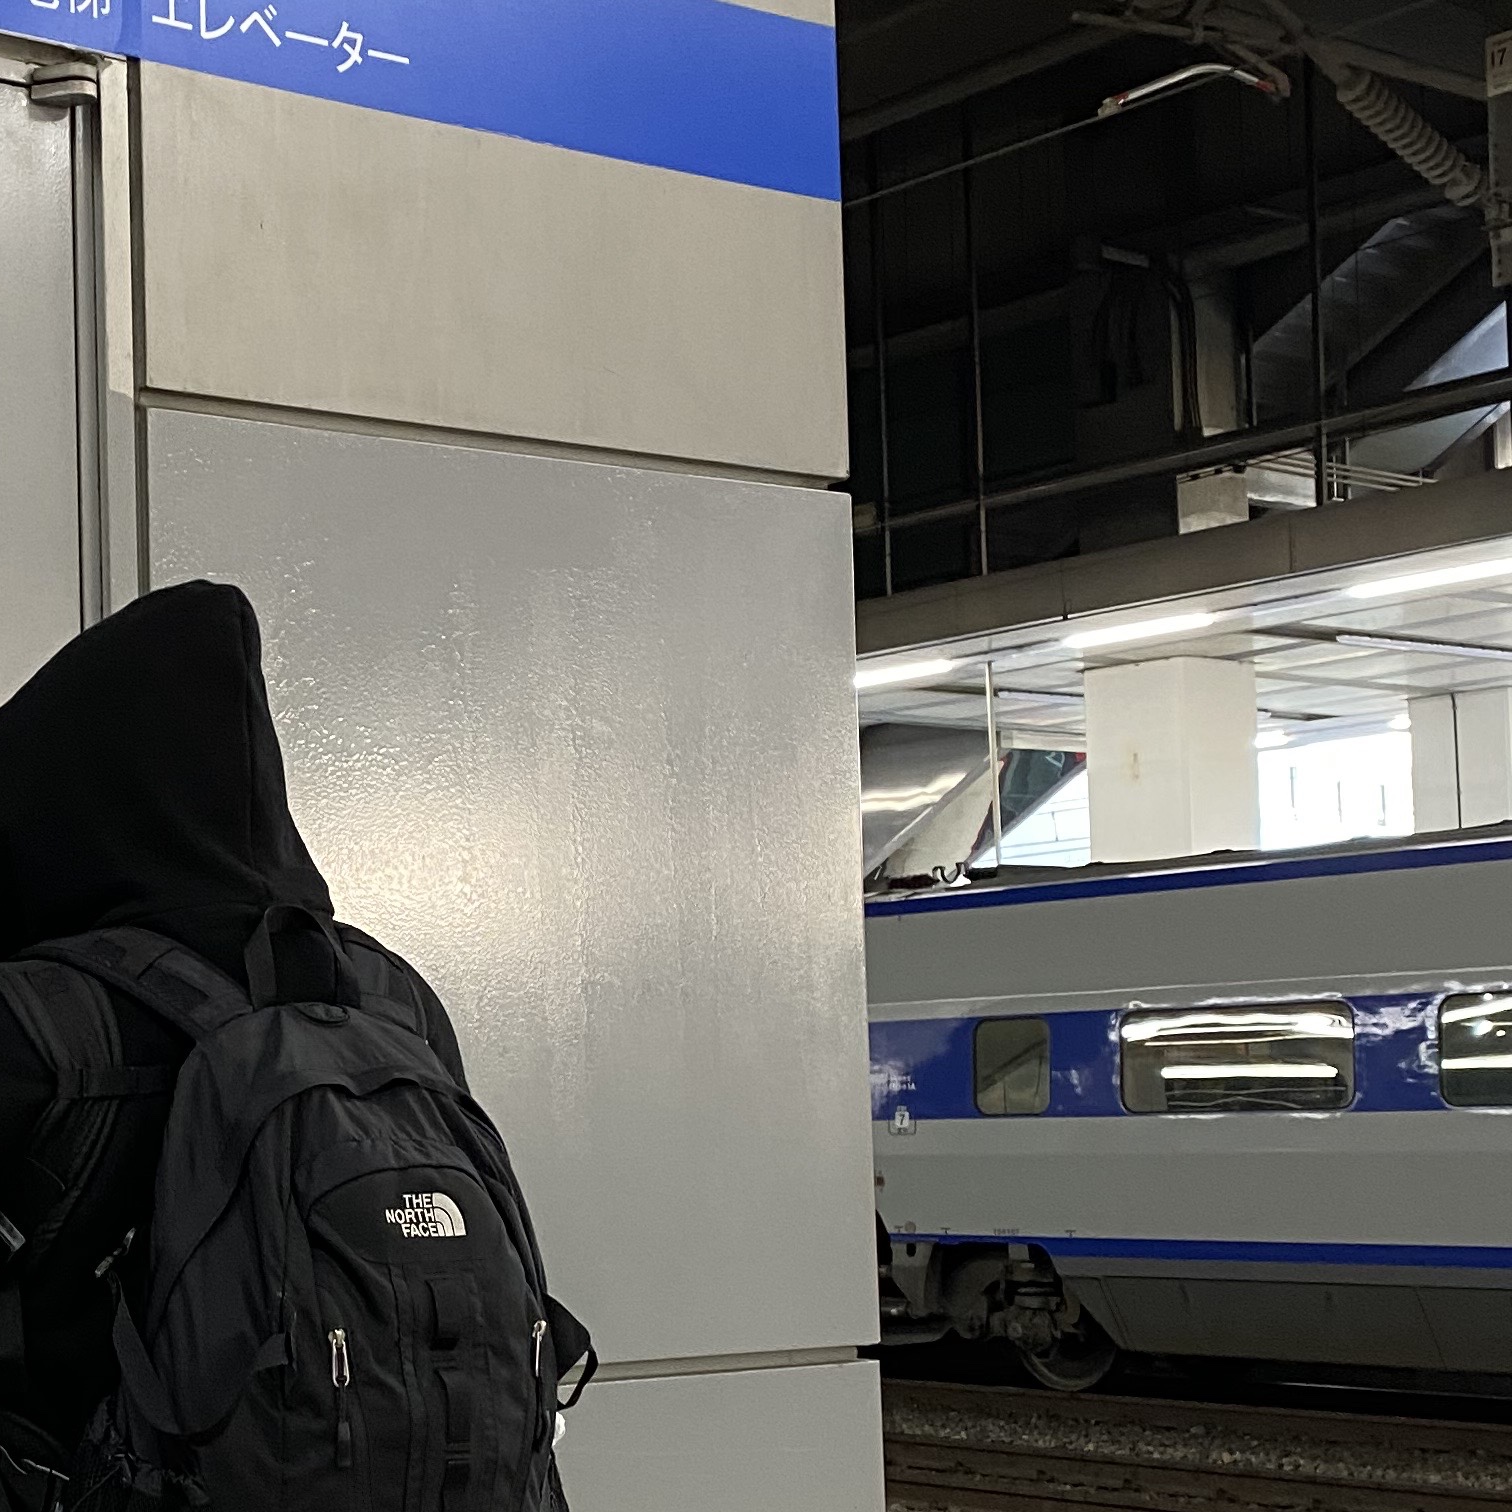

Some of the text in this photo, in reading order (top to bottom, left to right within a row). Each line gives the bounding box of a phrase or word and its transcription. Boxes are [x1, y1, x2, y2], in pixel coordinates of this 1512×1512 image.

[403, 1193, 433, 1209] THE
[385, 1208, 435, 1224] NORTH
[401, 1222, 439, 1238] FACE
